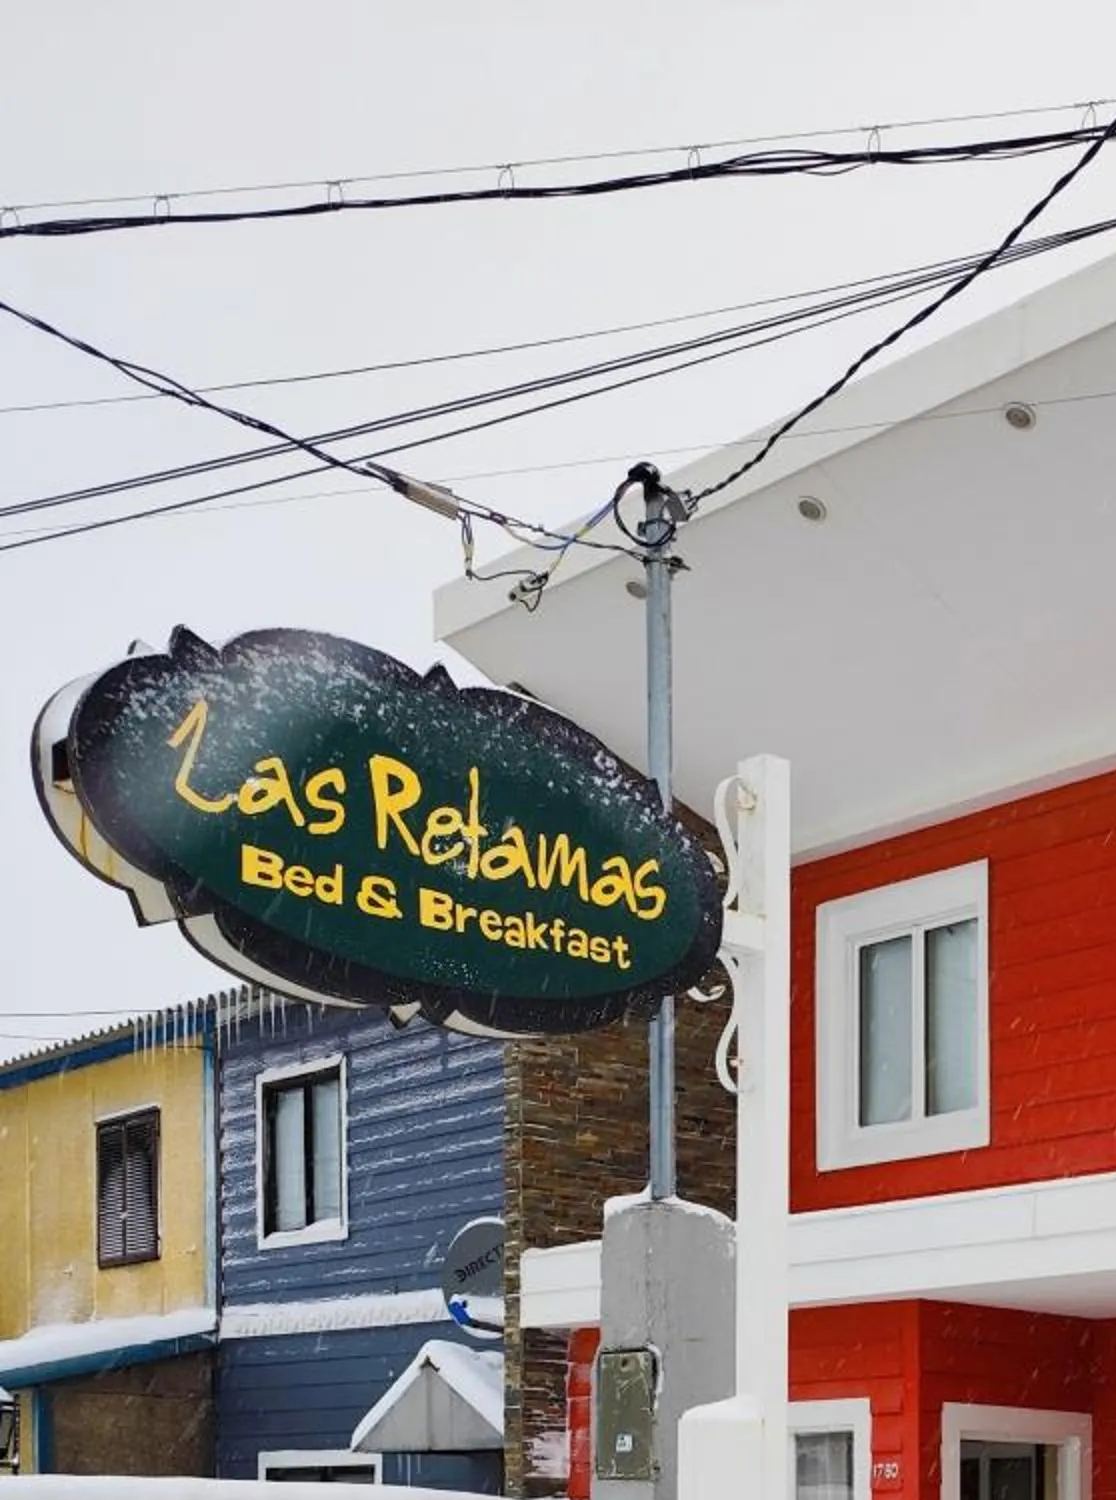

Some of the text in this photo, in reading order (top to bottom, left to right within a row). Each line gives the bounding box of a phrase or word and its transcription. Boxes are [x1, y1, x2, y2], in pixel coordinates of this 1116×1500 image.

[168, 700, 667, 920] Las Retamas
[241, 846, 632, 969] Bed & Breakfast
